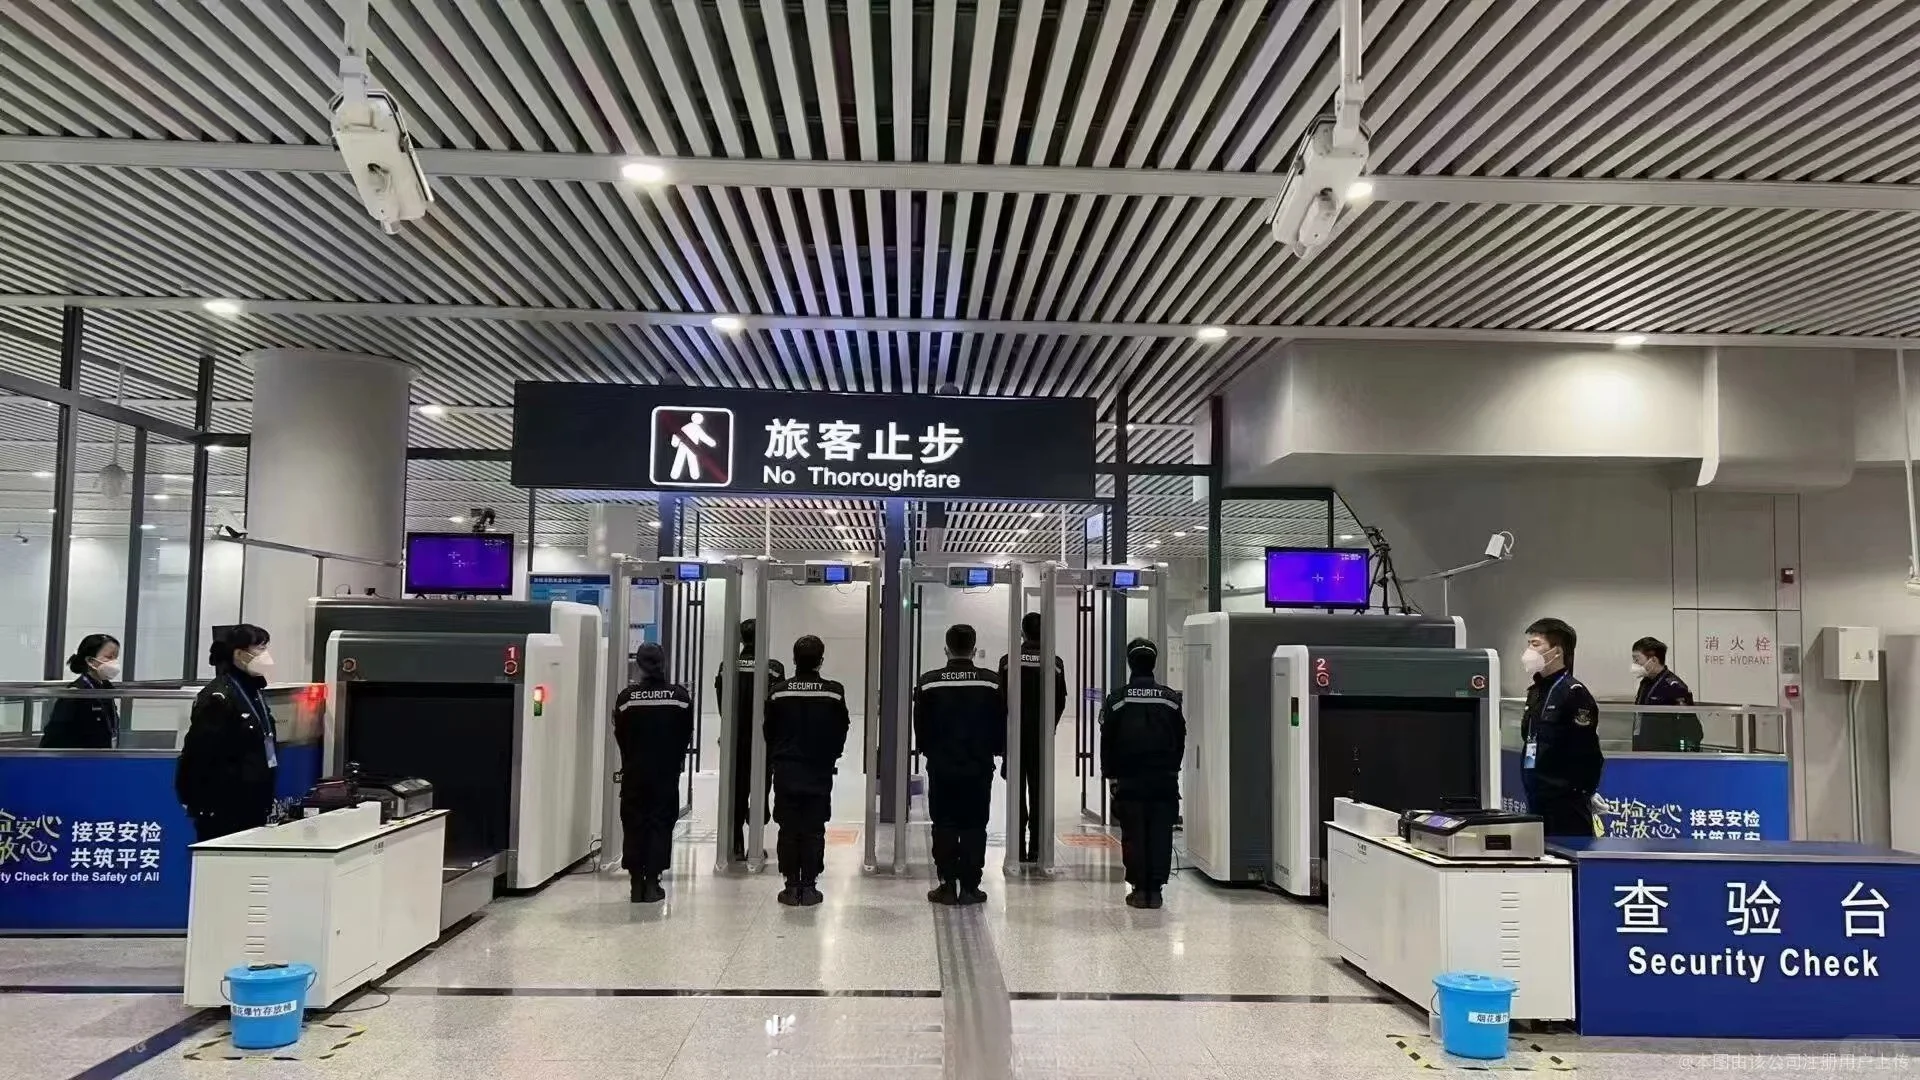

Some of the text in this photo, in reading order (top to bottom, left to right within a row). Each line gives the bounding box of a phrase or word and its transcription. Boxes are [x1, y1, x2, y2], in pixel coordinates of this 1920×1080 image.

[764, 418, 964, 464] 旅客止步
[763, 465, 960, 491] No Thoroughfare
[1705, 636, 1771, 652] 消火栓
[508, 646, 516, 659] 1
[1317, 658, 1327, 671] 2
[1705, 656, 1771, 665] FIRE HYDRANT
[941, 671, 977, 680] SECURITY
[787, 681, 823, 691] SECURITY
[1127, 688, 1163, 697] SECURITY
[630, 690, 675, 700] SECURITY
[1689, 808, 1761, 828] 接受安检
[71, 821, 161, 843] 接受安检
[70, 847, 160, 869] 共筑平安
[14, 872, 49, 882] Check
[52, 872, 68, 882] for
[71, 872, 89, 882] the
[92, 872, 127, 884] Safety
[130, 872, 142, 882] of
[144, 872, 160, 882] All
[1613, 878, 1890, 938] 查验台
[1628, 946, 1879, 983] Security Check
